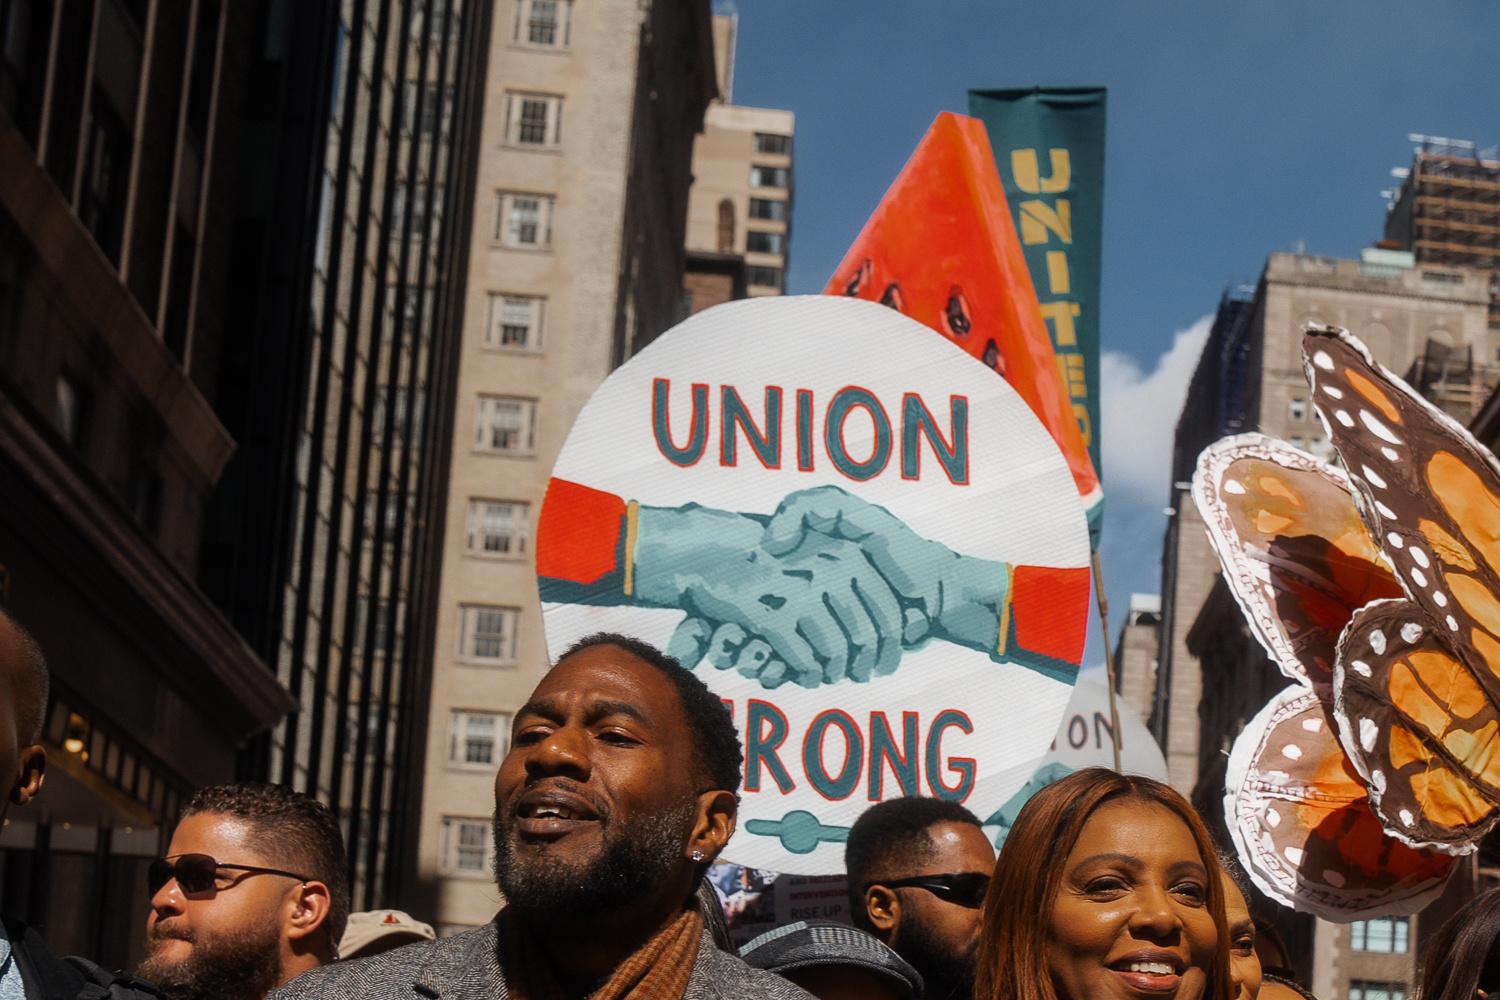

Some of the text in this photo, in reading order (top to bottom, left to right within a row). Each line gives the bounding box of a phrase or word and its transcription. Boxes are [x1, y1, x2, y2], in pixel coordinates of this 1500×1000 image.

[652, 377, 970, 486] UNION
[720, 697, 977, 804] RONG
[789, 904, 842, 919] RISE UP
